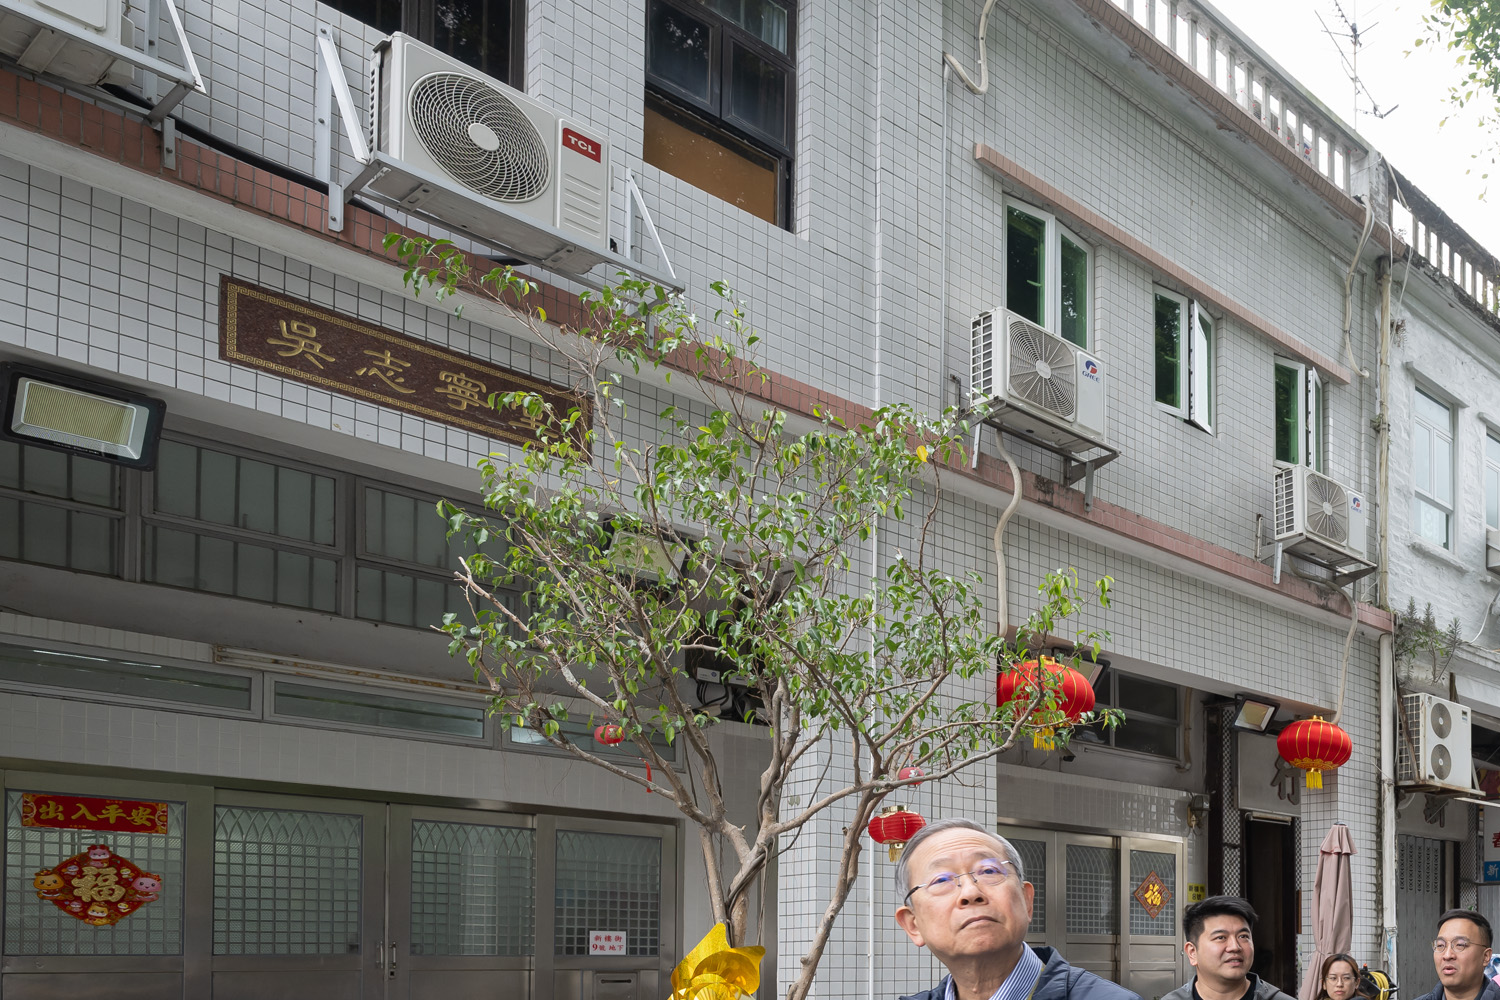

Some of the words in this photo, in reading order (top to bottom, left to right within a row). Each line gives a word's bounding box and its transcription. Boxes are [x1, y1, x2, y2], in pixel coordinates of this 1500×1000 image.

[567, 134, 596, 155] TCL
[1082, 370, 1100, 383] GREE
[38, 800, 155, 827] 出入平安
[71, 866, 126, 902] 福
[1144, 883, 1162, 906] 福
